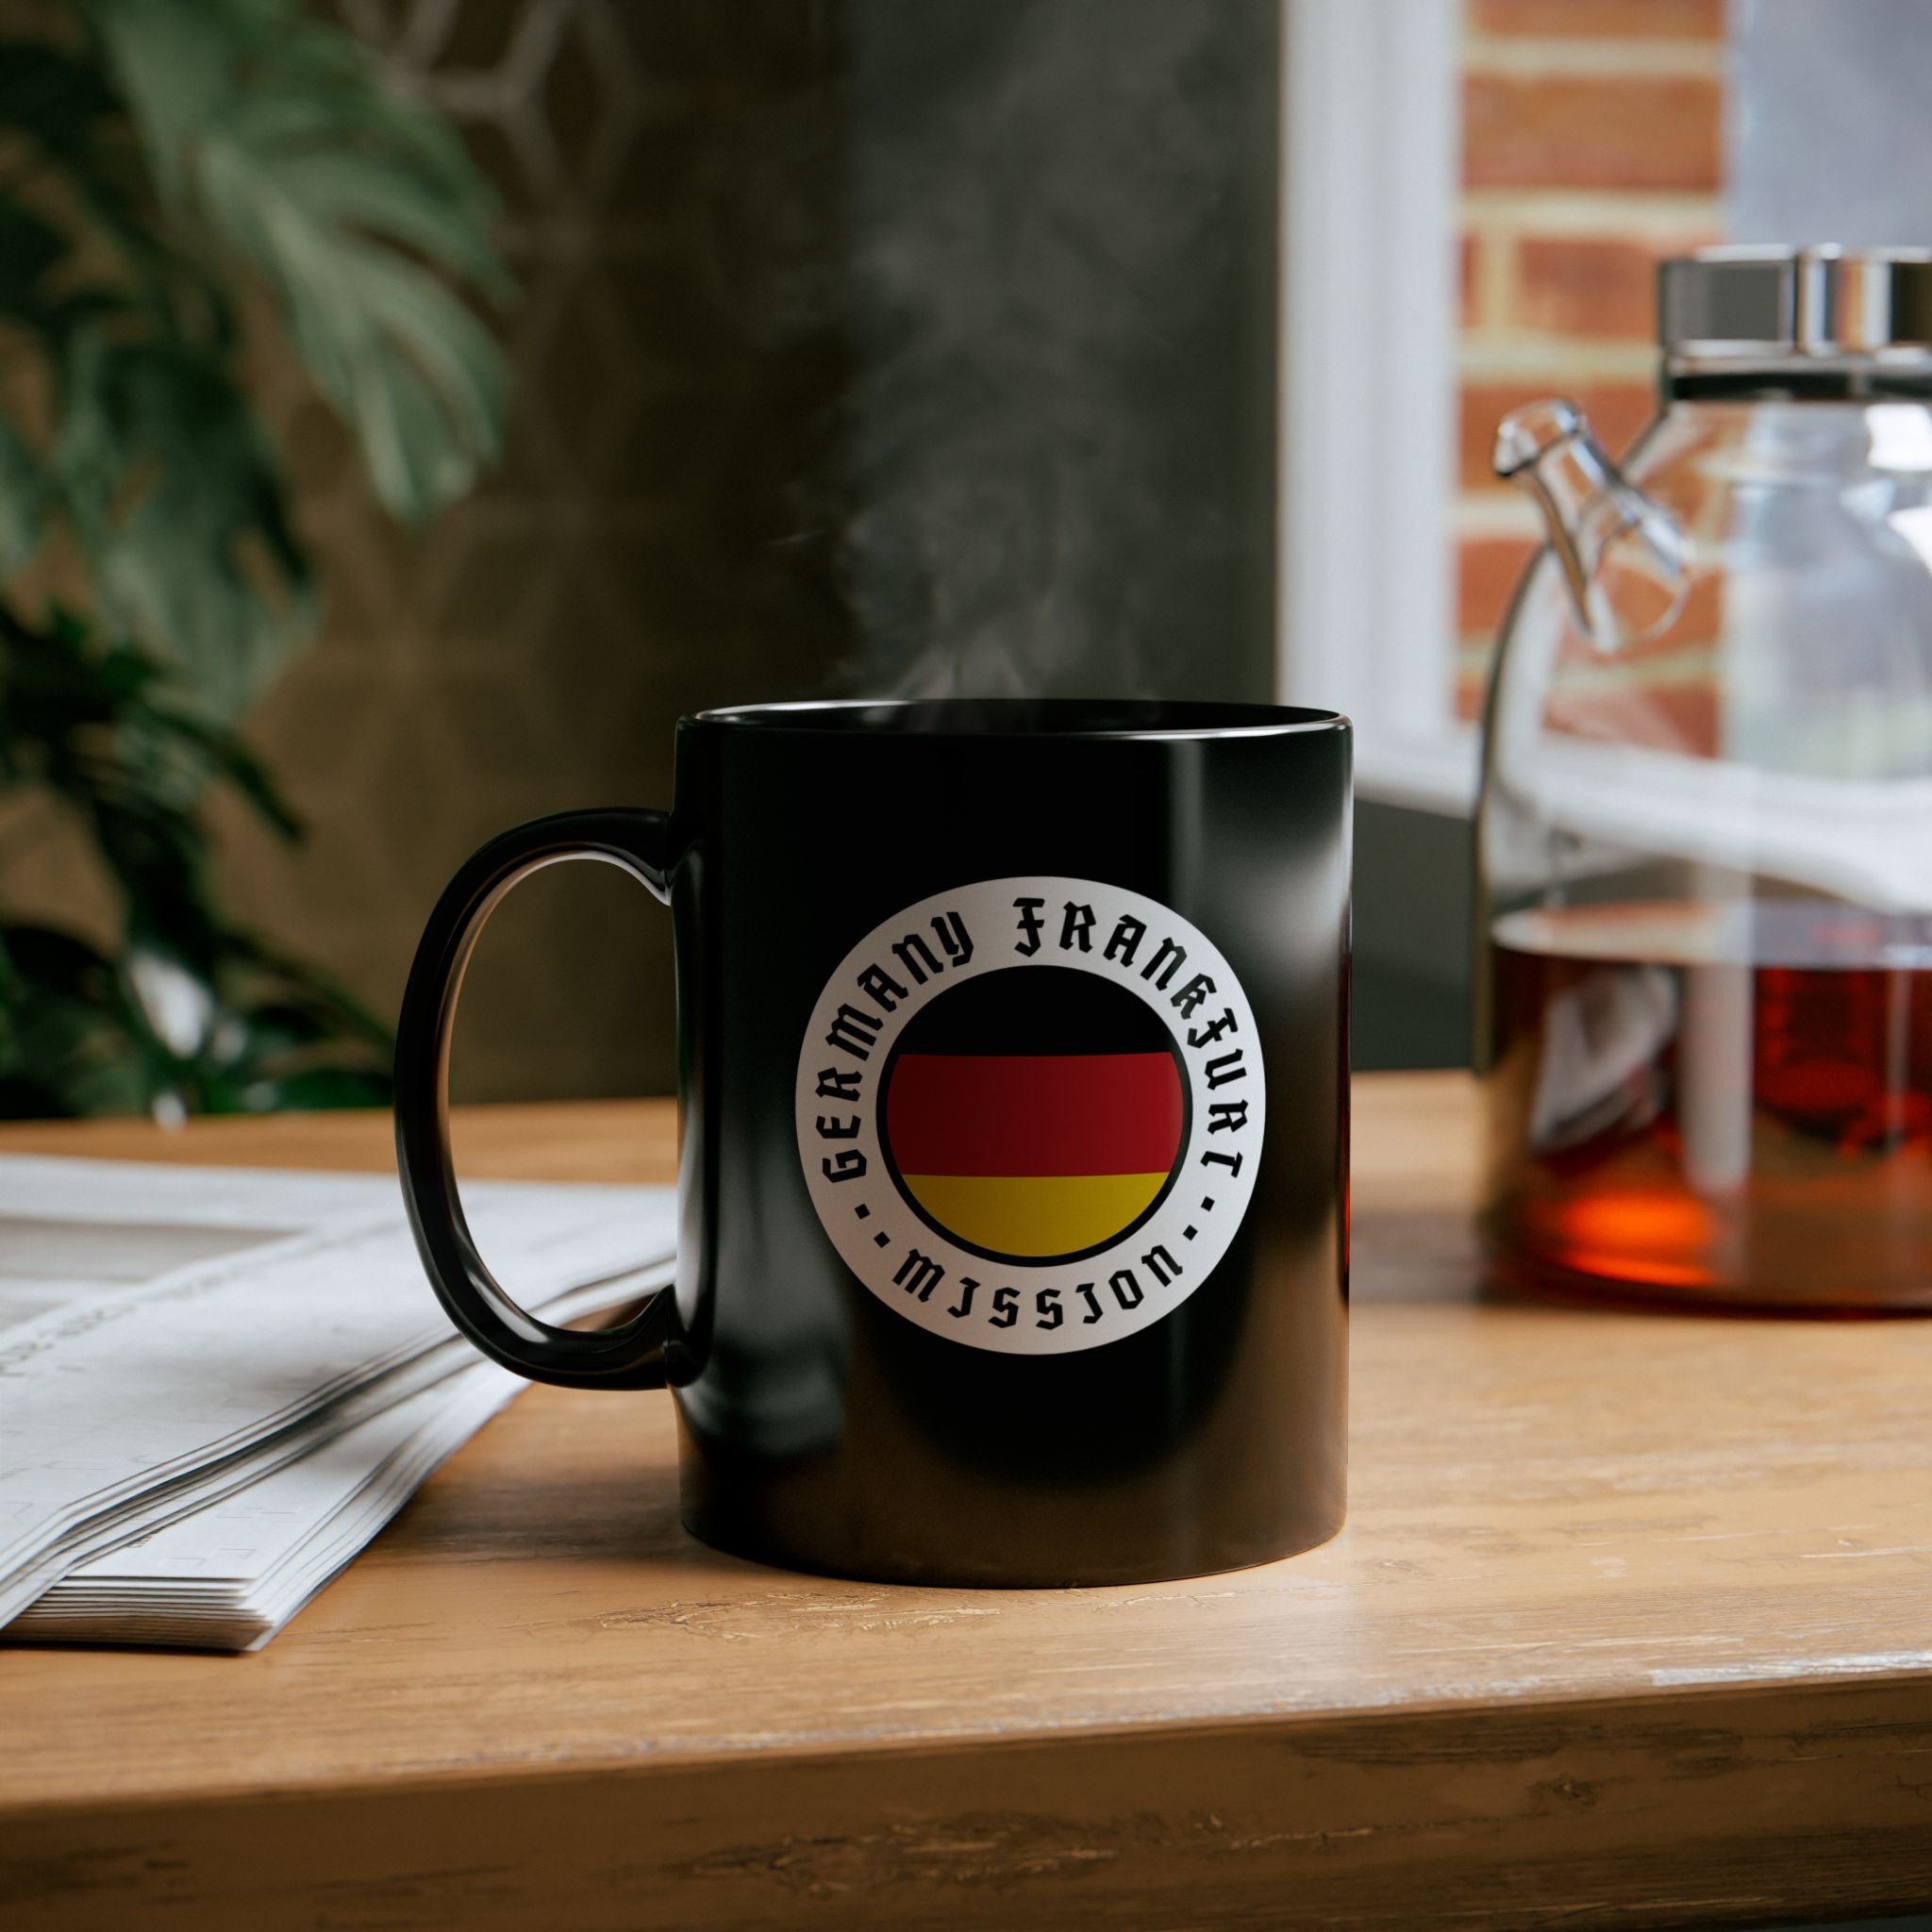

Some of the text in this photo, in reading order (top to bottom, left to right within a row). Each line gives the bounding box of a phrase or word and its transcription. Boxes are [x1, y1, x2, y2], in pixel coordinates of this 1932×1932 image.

[814, 896, 1249, 1184] GERMANY FRANKFURT
[891, 1244, 1183, 1331] MISSION
